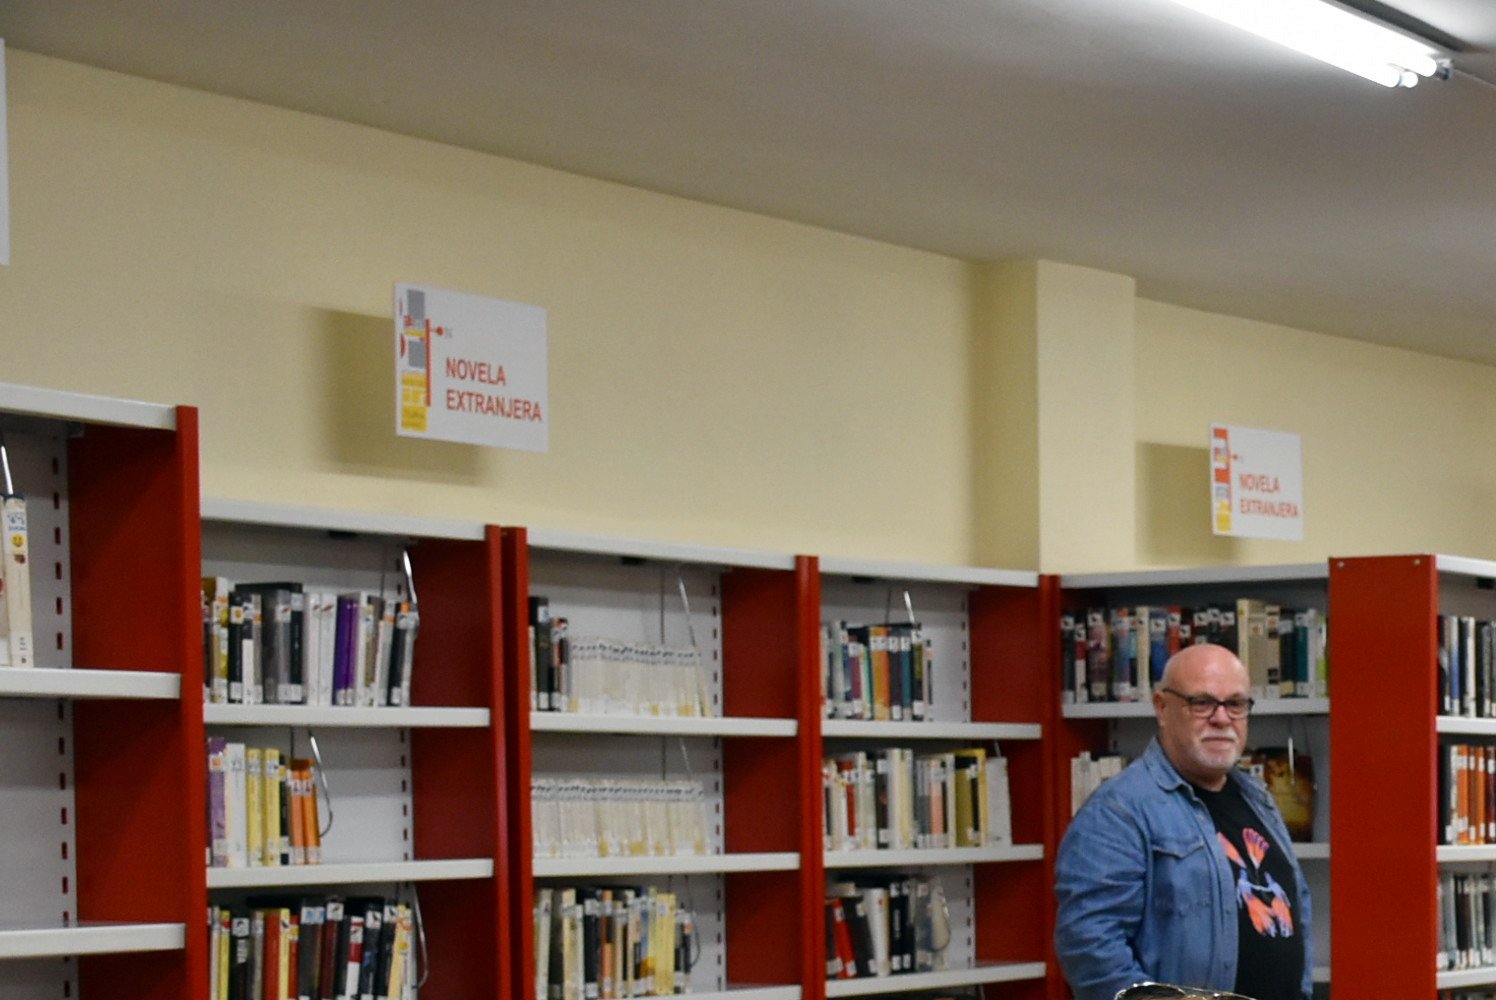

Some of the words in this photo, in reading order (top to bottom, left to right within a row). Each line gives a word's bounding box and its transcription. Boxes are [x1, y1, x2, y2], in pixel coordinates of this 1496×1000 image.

[445, 357, 506, 386] NOVELA
[446, 388, 542, 422] EXTRANJERA
[1240, 474, 1280, 493] NOVELA
